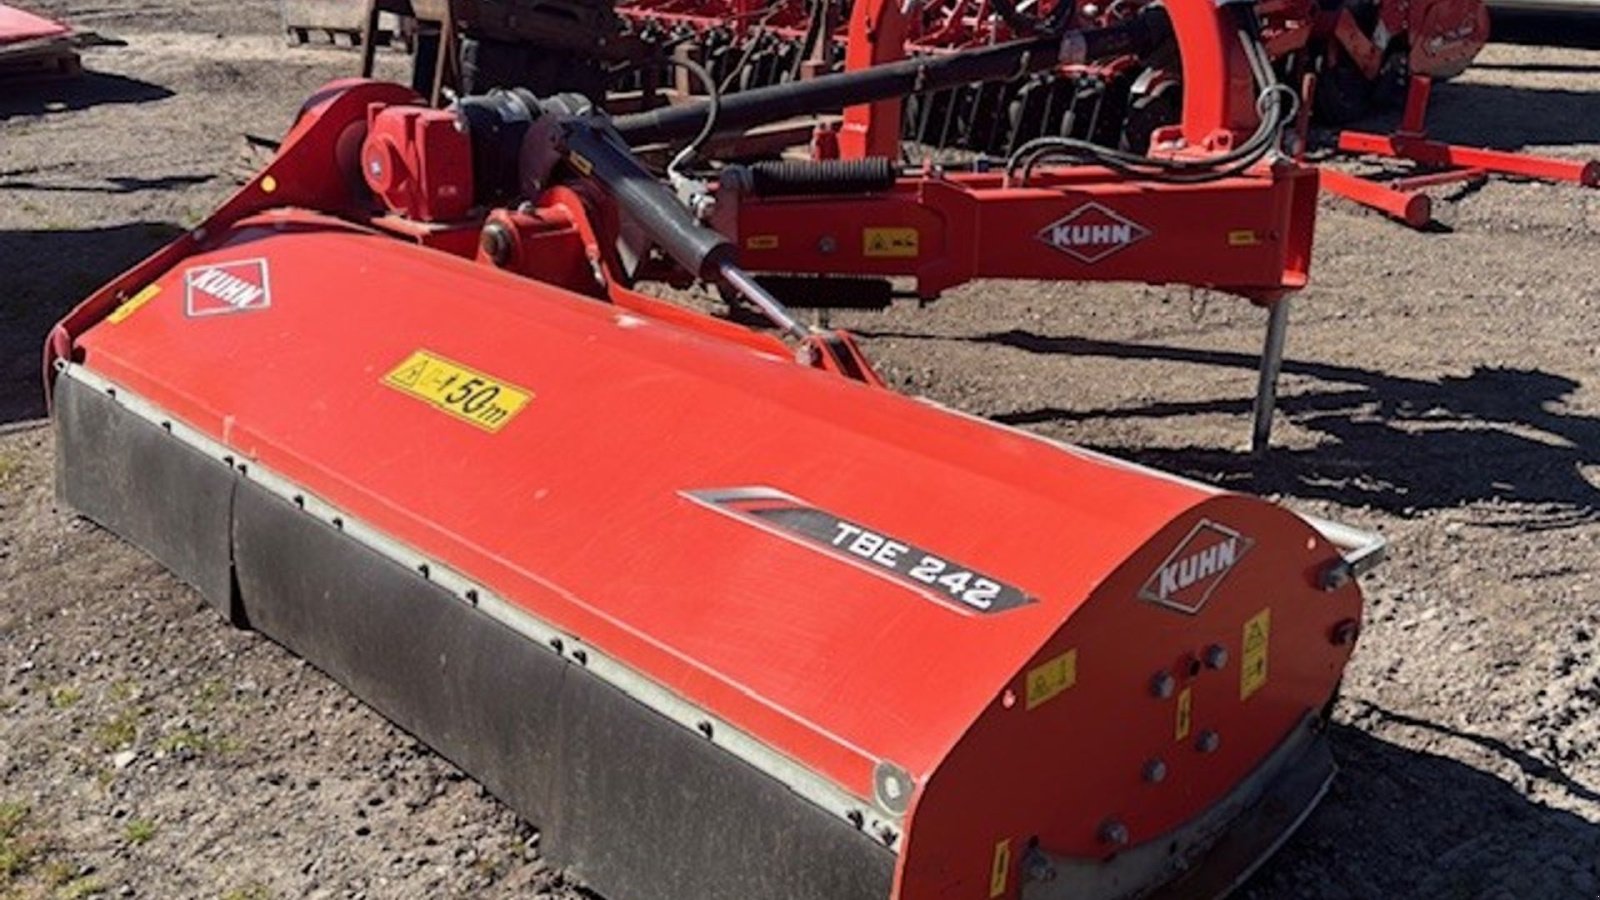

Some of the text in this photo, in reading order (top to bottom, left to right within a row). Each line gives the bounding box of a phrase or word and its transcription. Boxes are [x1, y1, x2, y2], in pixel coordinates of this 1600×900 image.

[1053, 225, 1130, 246] KUHN
[190, 268, 264, 309] KUHN
[832, 521, 1002, 610] TBE 242
[1160, 537, 1237, 600] KUHN
